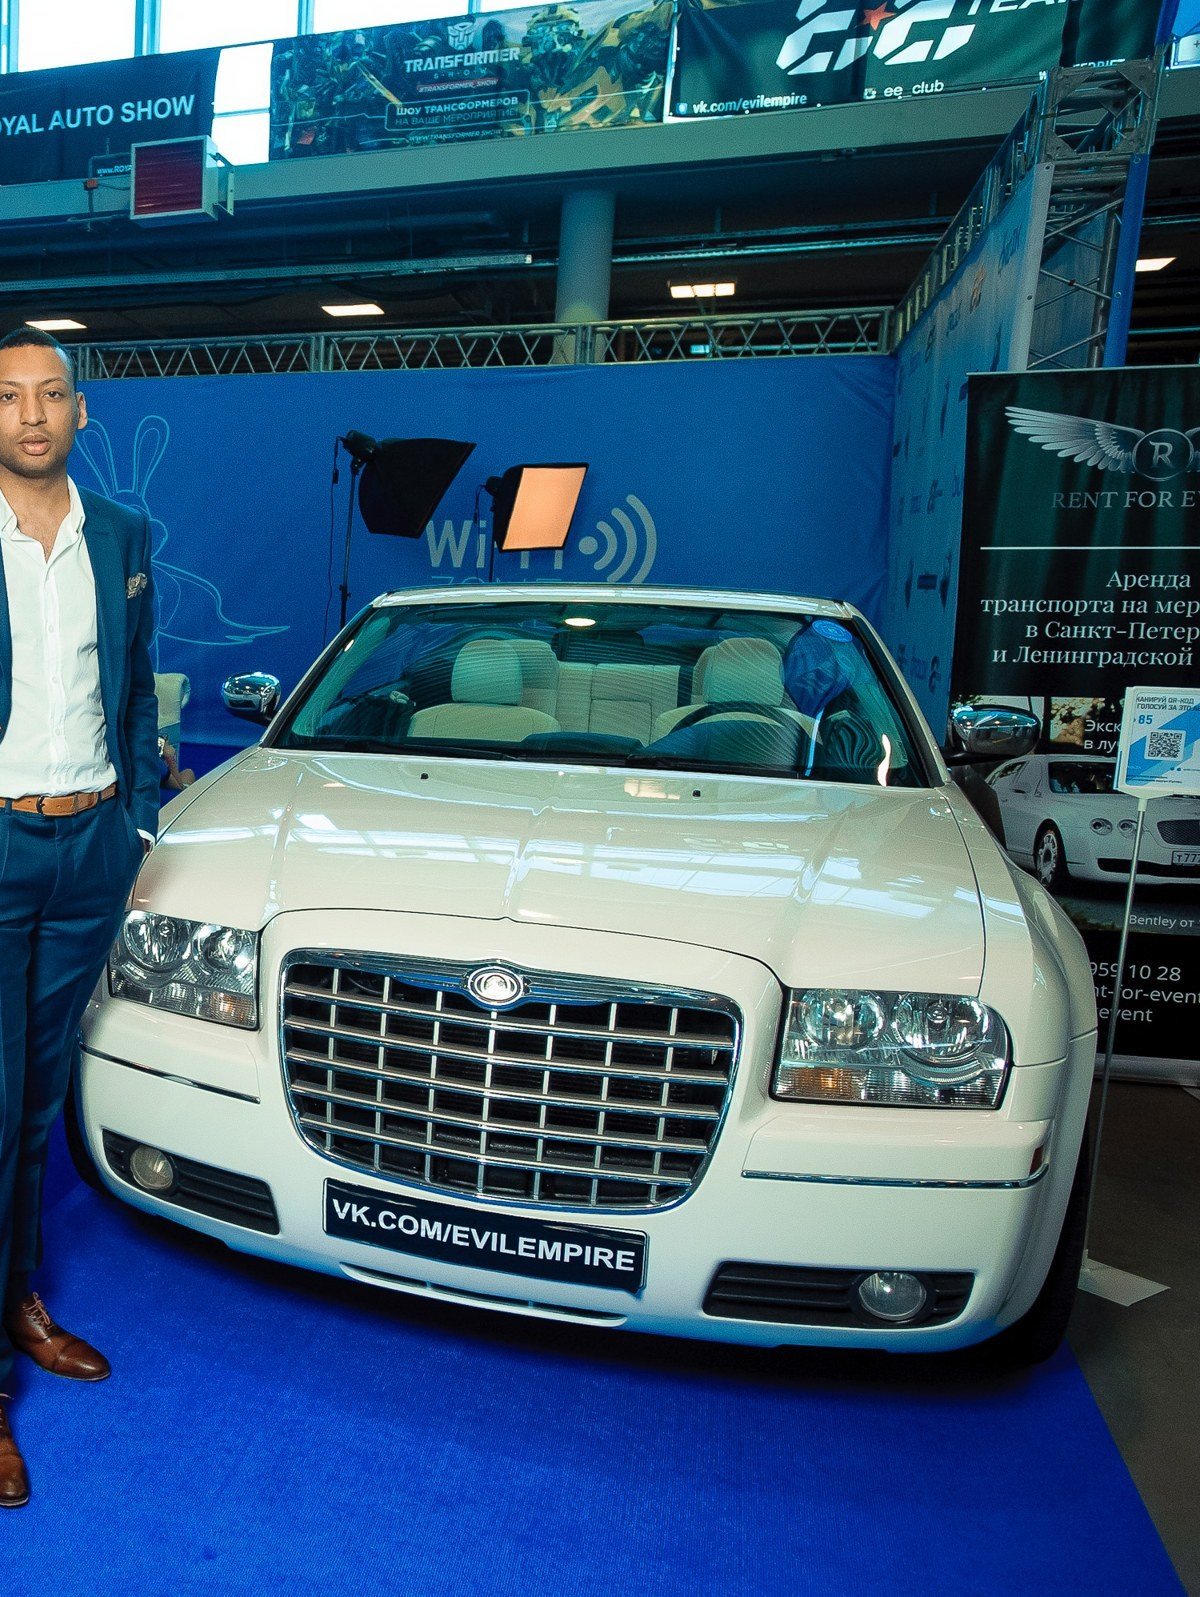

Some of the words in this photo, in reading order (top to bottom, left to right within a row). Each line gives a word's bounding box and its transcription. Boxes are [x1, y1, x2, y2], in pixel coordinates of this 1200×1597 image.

[404, 47, 520, 73] TRANSFORMER
[883, 80, 944, 99] ee_club
[48, 104, 113, 130] AUTO
[120, 94, 195, 123] SHOW
[396, 106, 421, 116] ШОУ
[424, 96, 519, 114] ТРАНСФОРМЕРОВ
[692, 94, 807, 114] vk.com/evilempire
[1052, 491, 1118, 509] RENT
[1124, 491, 1175, 508] FOR
[1105, 571, 1192, 591] Аренда
[981, 599, 1115, 616] транспорта
[1121, 600, 1148, 614] на
[1025, 625, 1039, 638] в
[992, 650, 1007, 663] и
[1012, 646, 1194, 668] Ленинградской
[1138, 714, 1153, 725] 85
[1083, 739, 1094, 750] в
[1129, 914, 1177, 929] Bentley
[1129, 964, 1151, 979] 10
[1157, 966, 1182, 981] 28
[333, 1199, 635, 1272] VK.COM/EVILEMPIRE
